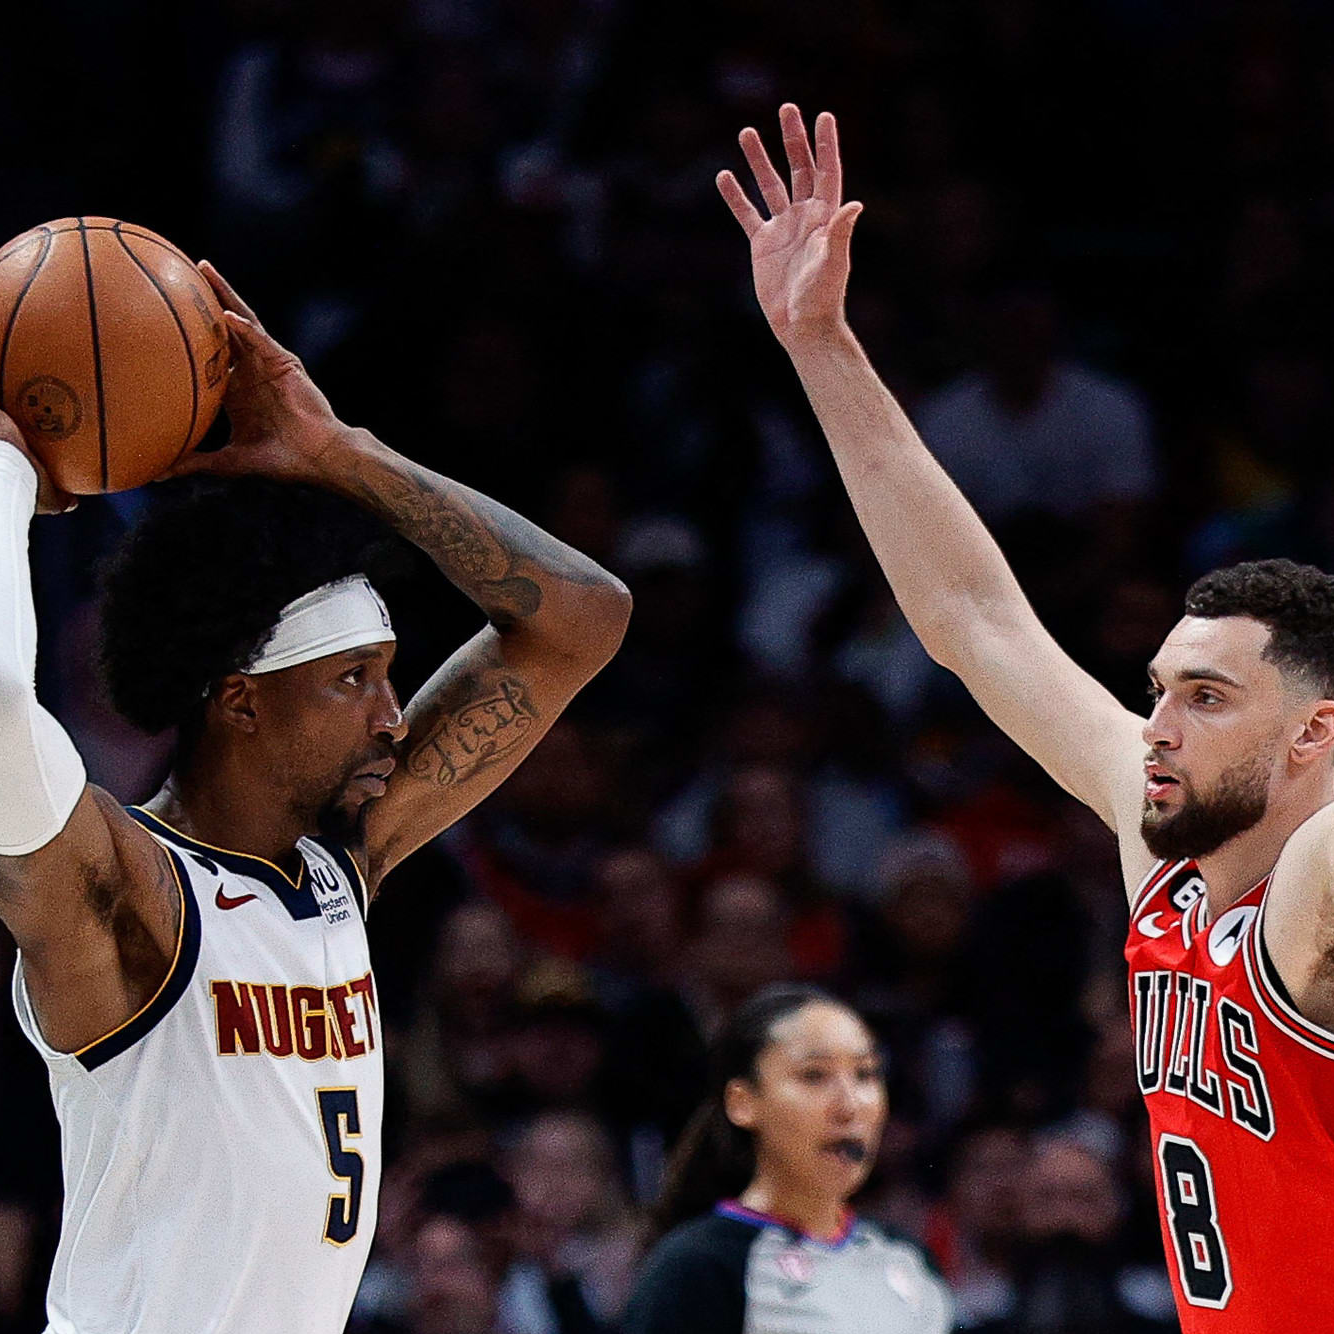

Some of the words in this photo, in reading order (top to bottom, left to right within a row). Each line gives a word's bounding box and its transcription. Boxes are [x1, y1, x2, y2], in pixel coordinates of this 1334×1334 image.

[1173, 877, 1206, 910] 6
[315, 1086, 363, 1248] 5
[1158, 1133, 1234, 1310] 8
